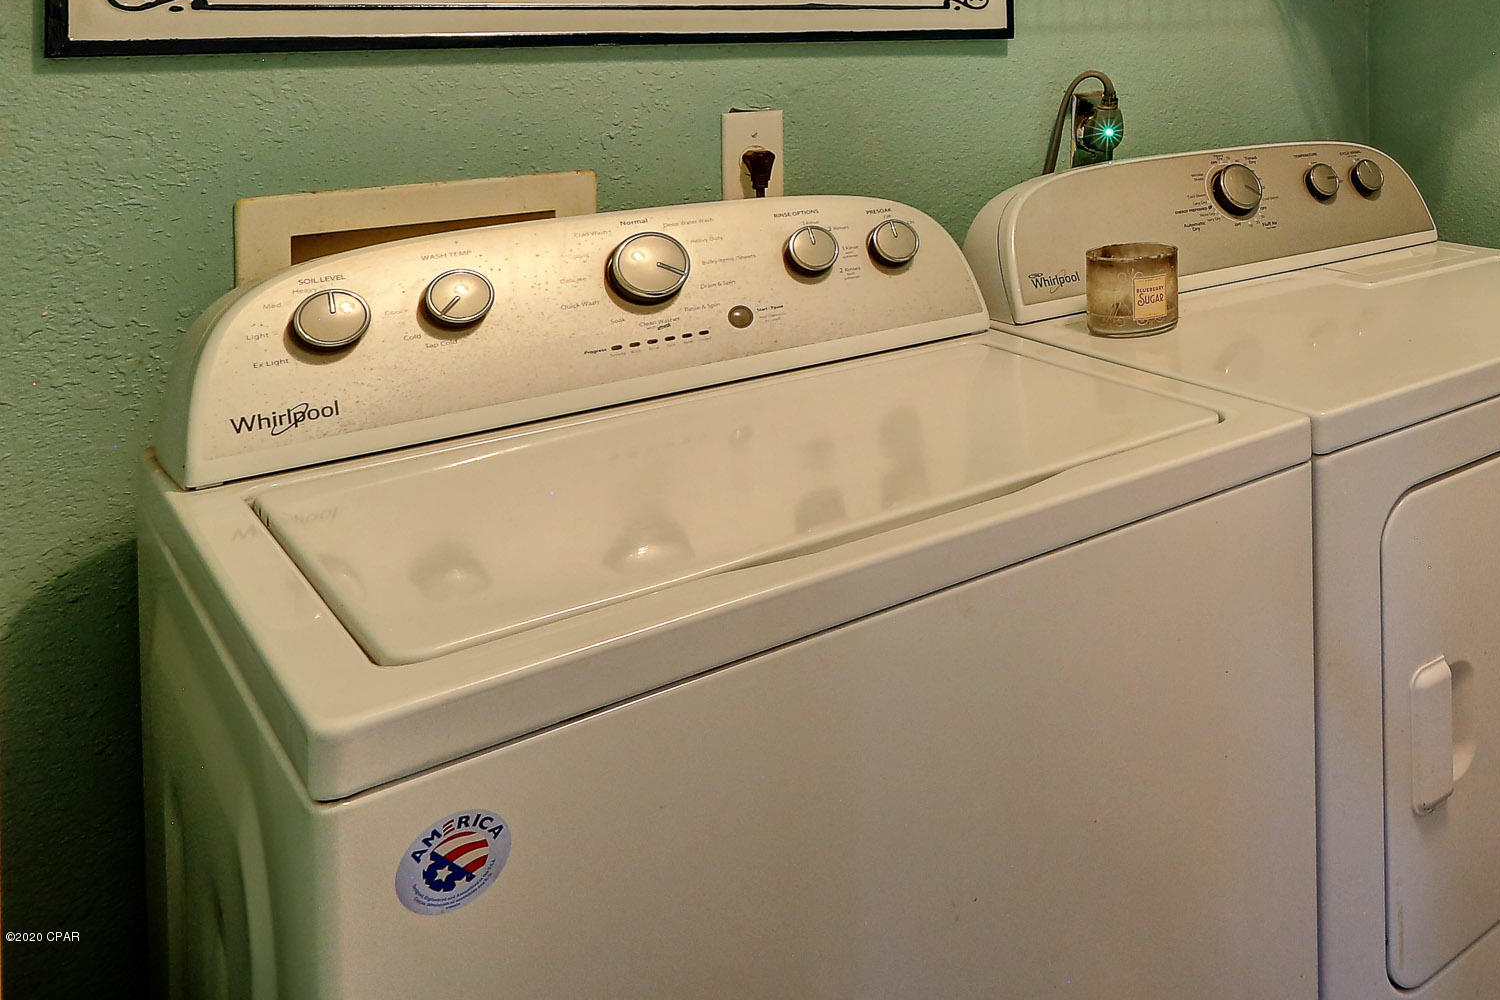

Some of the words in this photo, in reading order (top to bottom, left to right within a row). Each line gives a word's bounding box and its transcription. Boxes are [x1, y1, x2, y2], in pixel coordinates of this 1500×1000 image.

[792, 208, 820, 216] OPTIONS
[620, 217, 649, 227] Normal
[320, 274, 346, 282] LEVEL
[1031, 270, 1081, 292] Whirlpool
[1136, 284, 1165, 294] BLUEBERRY
[262, 301, 282, 310] Med
[246, 332, 269, 342] Light
[403, 333, 422, 341] Cold
[266, 357, 289, 368] Light
[229, 399, 340, 436] Whirlpool
